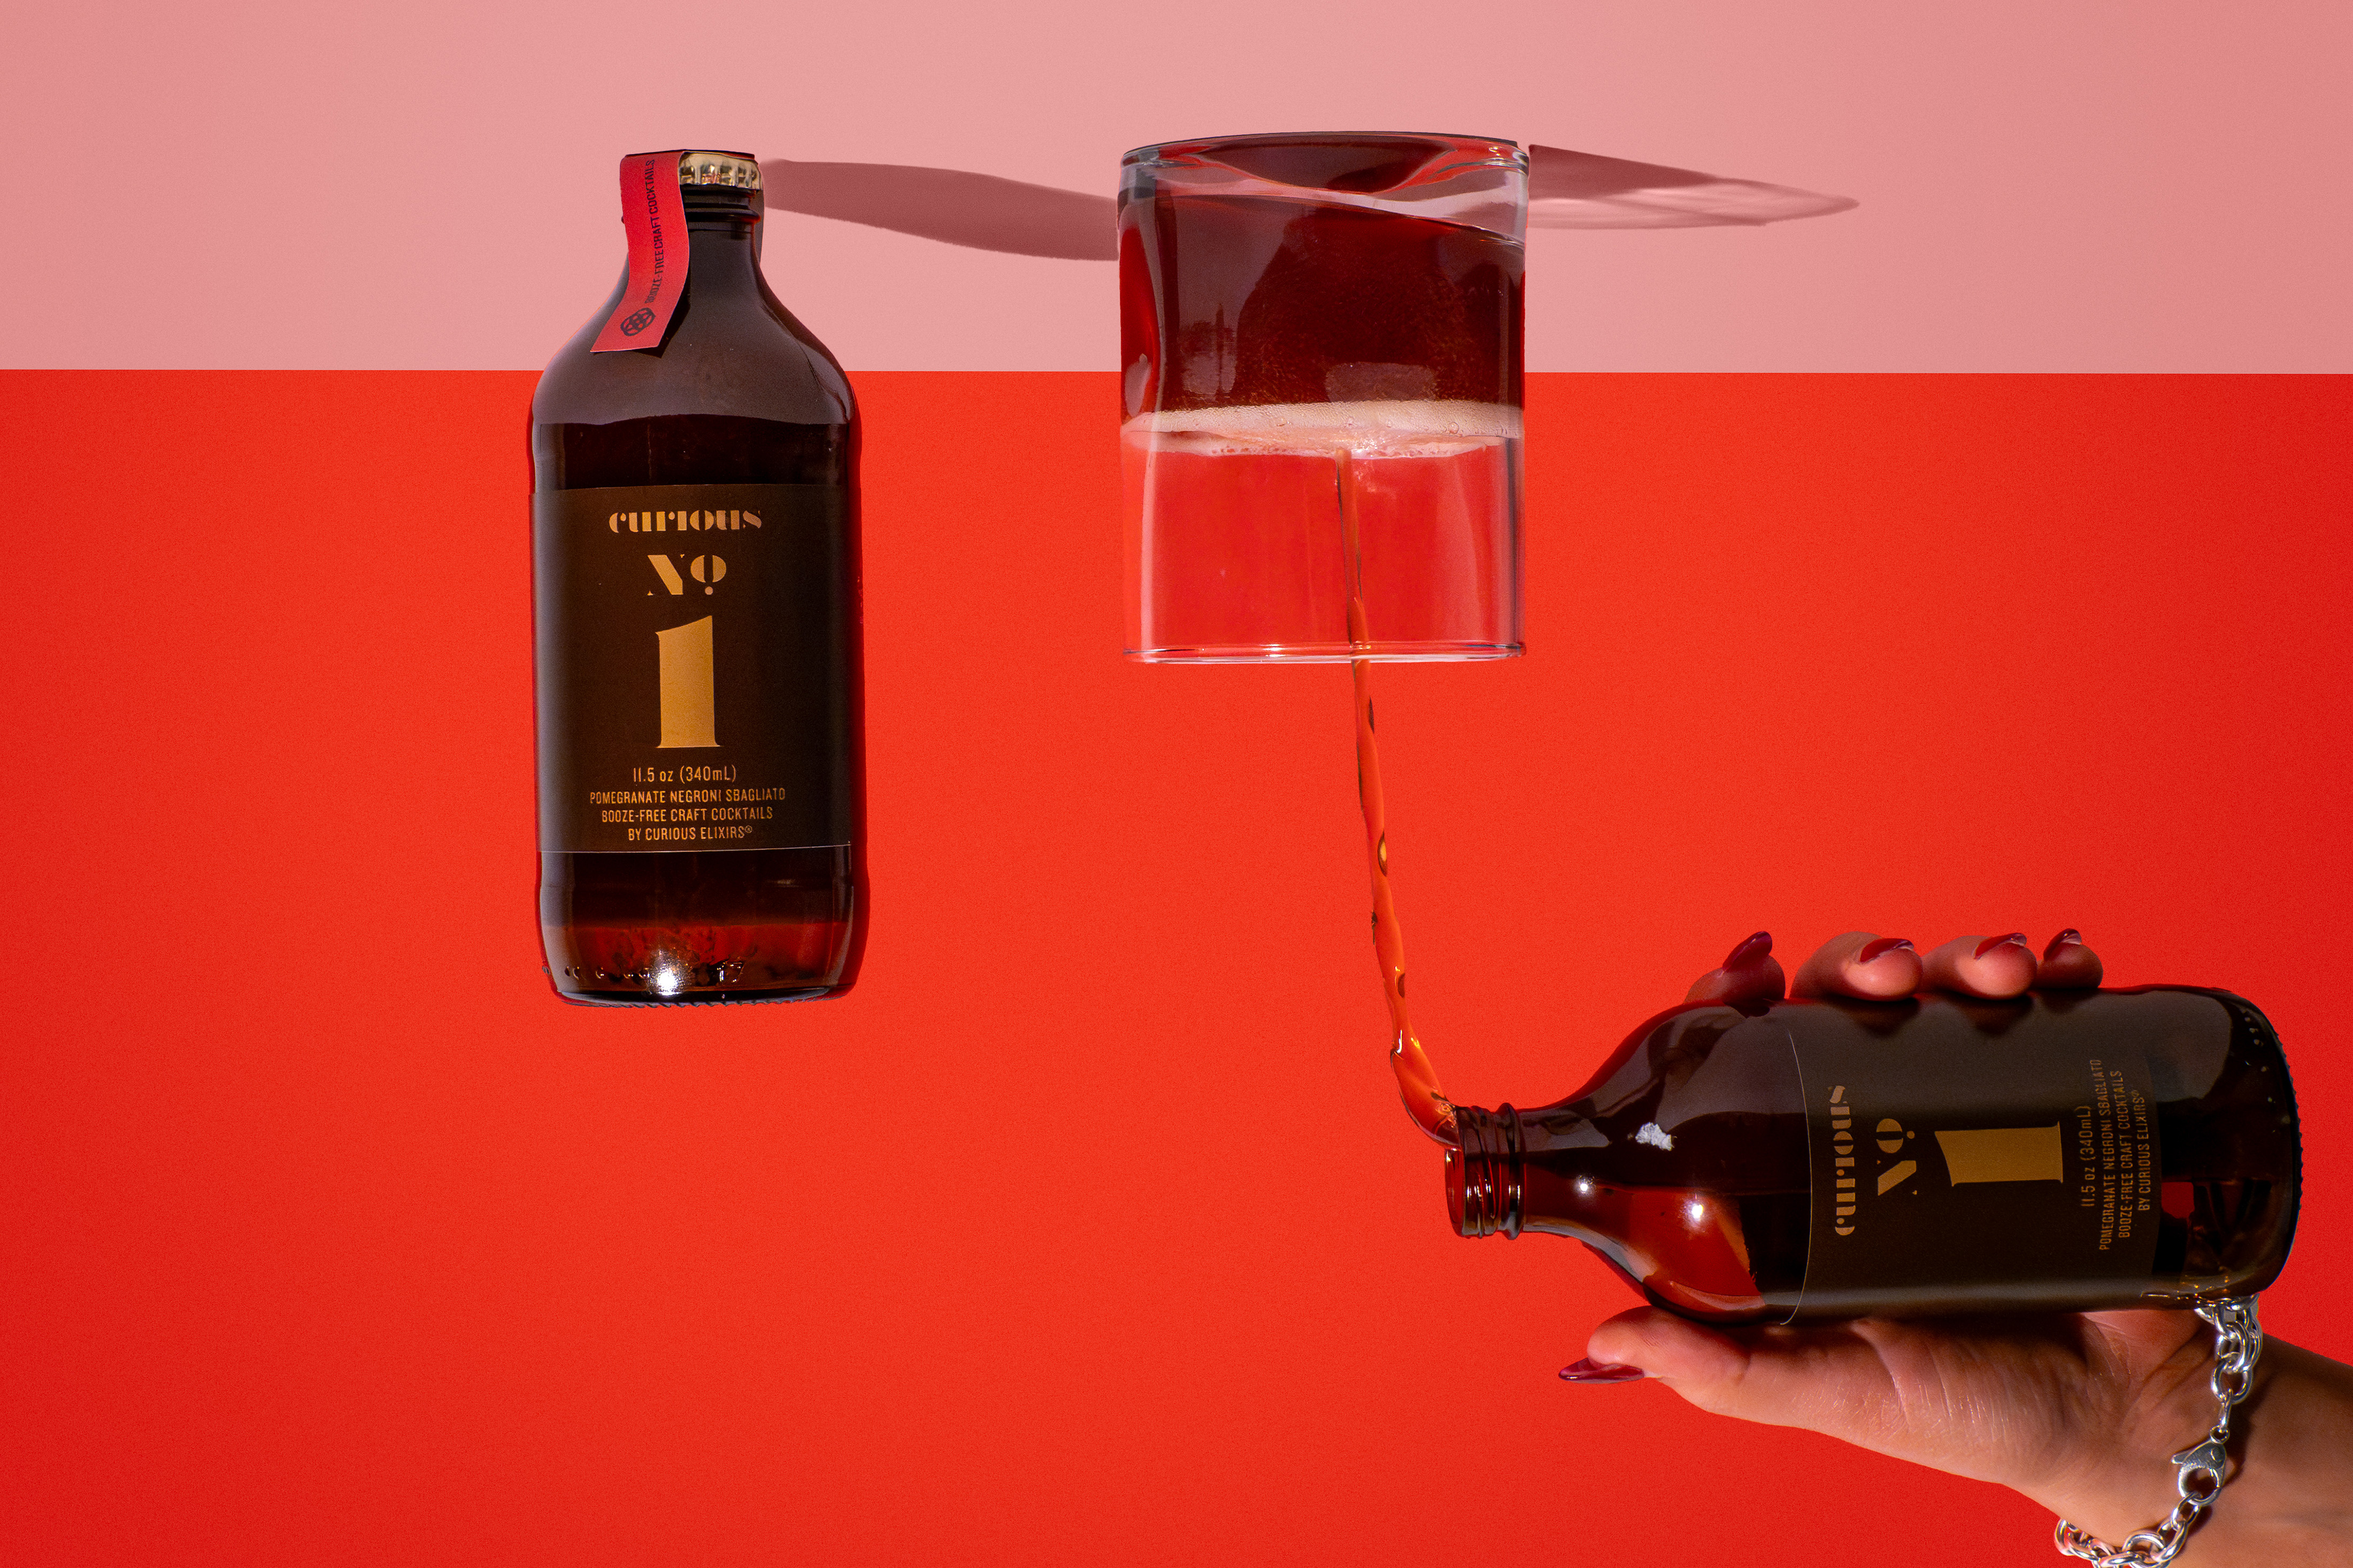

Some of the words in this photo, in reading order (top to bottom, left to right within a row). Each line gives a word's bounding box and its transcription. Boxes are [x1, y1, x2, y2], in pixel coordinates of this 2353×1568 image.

[644, 159, 659, 214] COCKTAILS
[650, 216, 664, 249] CRAFT
[609, 509, 762, 534] curious
[656, 615, 721, 748] 1
[590, 791, 666, 804] POMEGRANATE
[670, 789, 721, 803] NEGRONI
[726, 787, 786, 802] SBAGLIATO
[633, 767, 655, 782] 11.5
[659, 770, 674, 782] oz
[680, 764, 736, 784] (340mL)
[602, 809, 667, 823] BOOZE-FREE
[671, 808, 708, 822] CRAFT
[711, 806, 773, 821] COCKTAILS
[628, 828, 642, 841] BY
[645, 827, 696, 840] CURIOUS
[2090, 1060, 2111, 1116] SBAGLIATO
[2110, 1070, 2131, 1130] COCKTAILS
[1934, 1121, 2063, 1187] 1
[2074, 1106, 2096, 1161] (340mL)
[2100, 1120, 2116, 1170] NEGRONI
[2119, 1134, 2133, 1169] CRAFT
[1828, 1085, 1856, 1235] curious
[2085, 1167, 2095, 1180] oz
[2137, 1144, 2151, 1194] CURIOUS
[2080, 1185, 2095, 1207] 11.5
[2099, 1173, 2116, 1250] POMEGRANATE
[2118, 1173, 2134, 1238] BOOZE-FREE
[2137, 1198, 2150, 1211] BY
